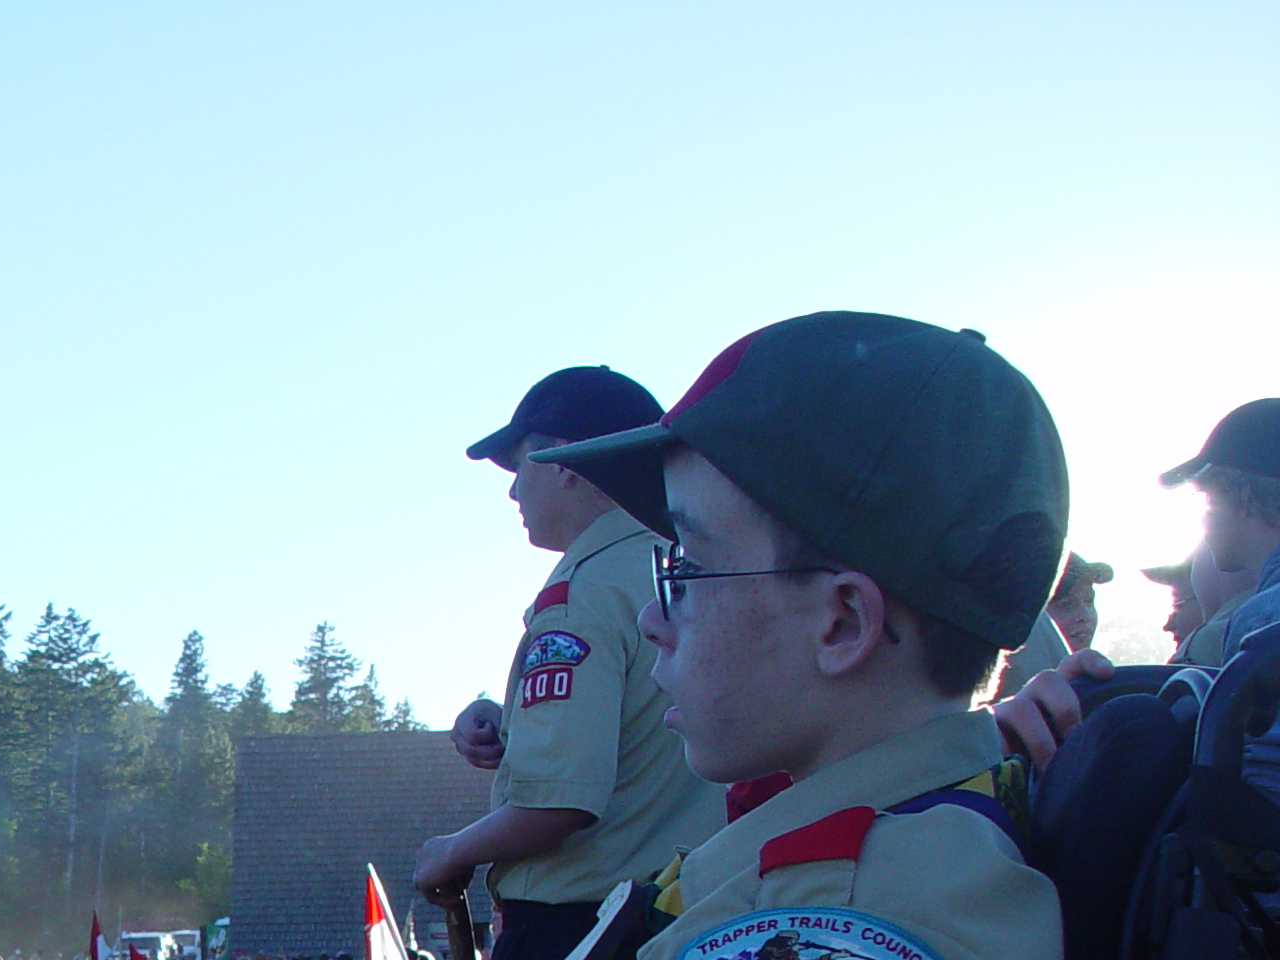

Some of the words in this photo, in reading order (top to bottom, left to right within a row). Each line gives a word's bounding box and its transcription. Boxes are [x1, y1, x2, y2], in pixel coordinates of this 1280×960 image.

[524, 672, 568, 702] 400
[696, 918, 779, 956] TRAPPER
[787, 916, 855, 934] TRAILS
